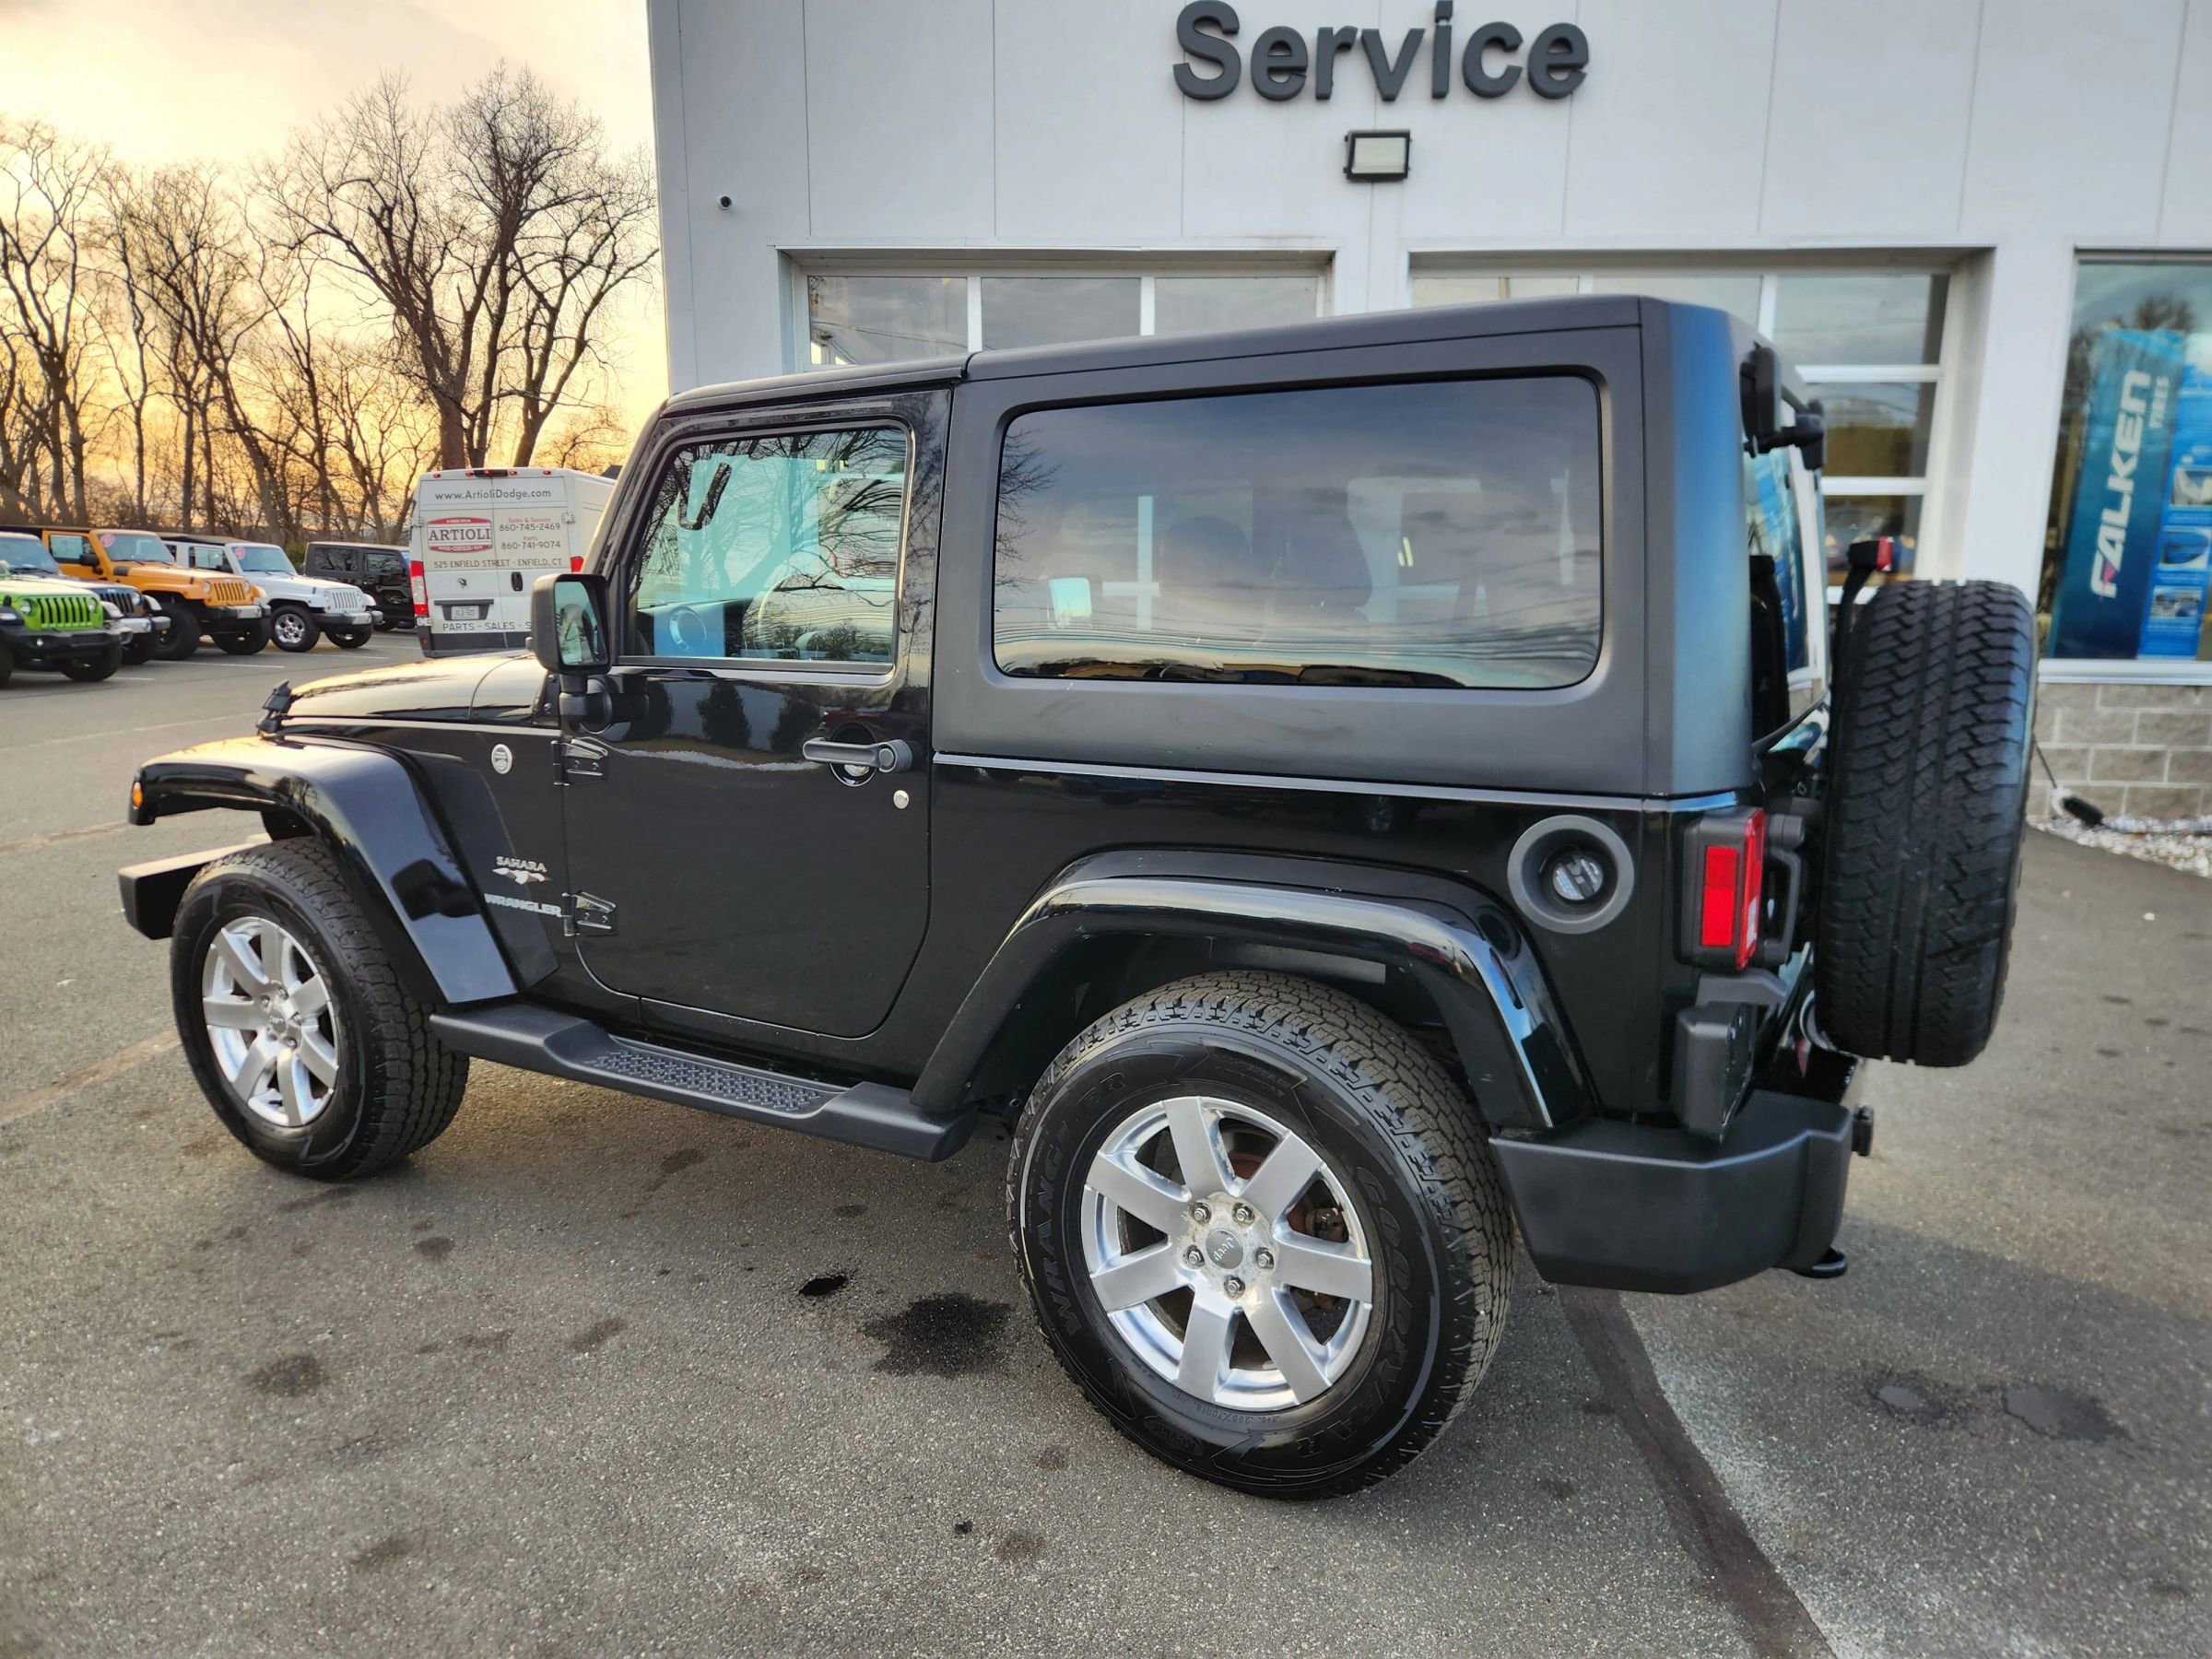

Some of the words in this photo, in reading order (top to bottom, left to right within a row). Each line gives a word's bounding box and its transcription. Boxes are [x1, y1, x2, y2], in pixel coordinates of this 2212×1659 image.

[1172, 0, 1589, 101] Service
[2090, 369, 2151, 599] FALKEN
[434, 488, 551, 500] www.ArtioliDodge.com
[499, 523, 560, 532] 860-745-2469
[429, 528, 491, 541] ARTIOLI
[501, 541, 561, 549] 860-741-9074
[433, 560, 448, 569] 525
[450, 559, 479, 568] ENFIELD
[482, 559, 511, 568] STREET
[551, 558, 562, 566] CT
[442, 623, 475, 631] PARTS
[485, 622, 515, 630] SALES
[496, 855, 547, 872] SAHARA
[484, 893, 562, 918] WRANGLER
